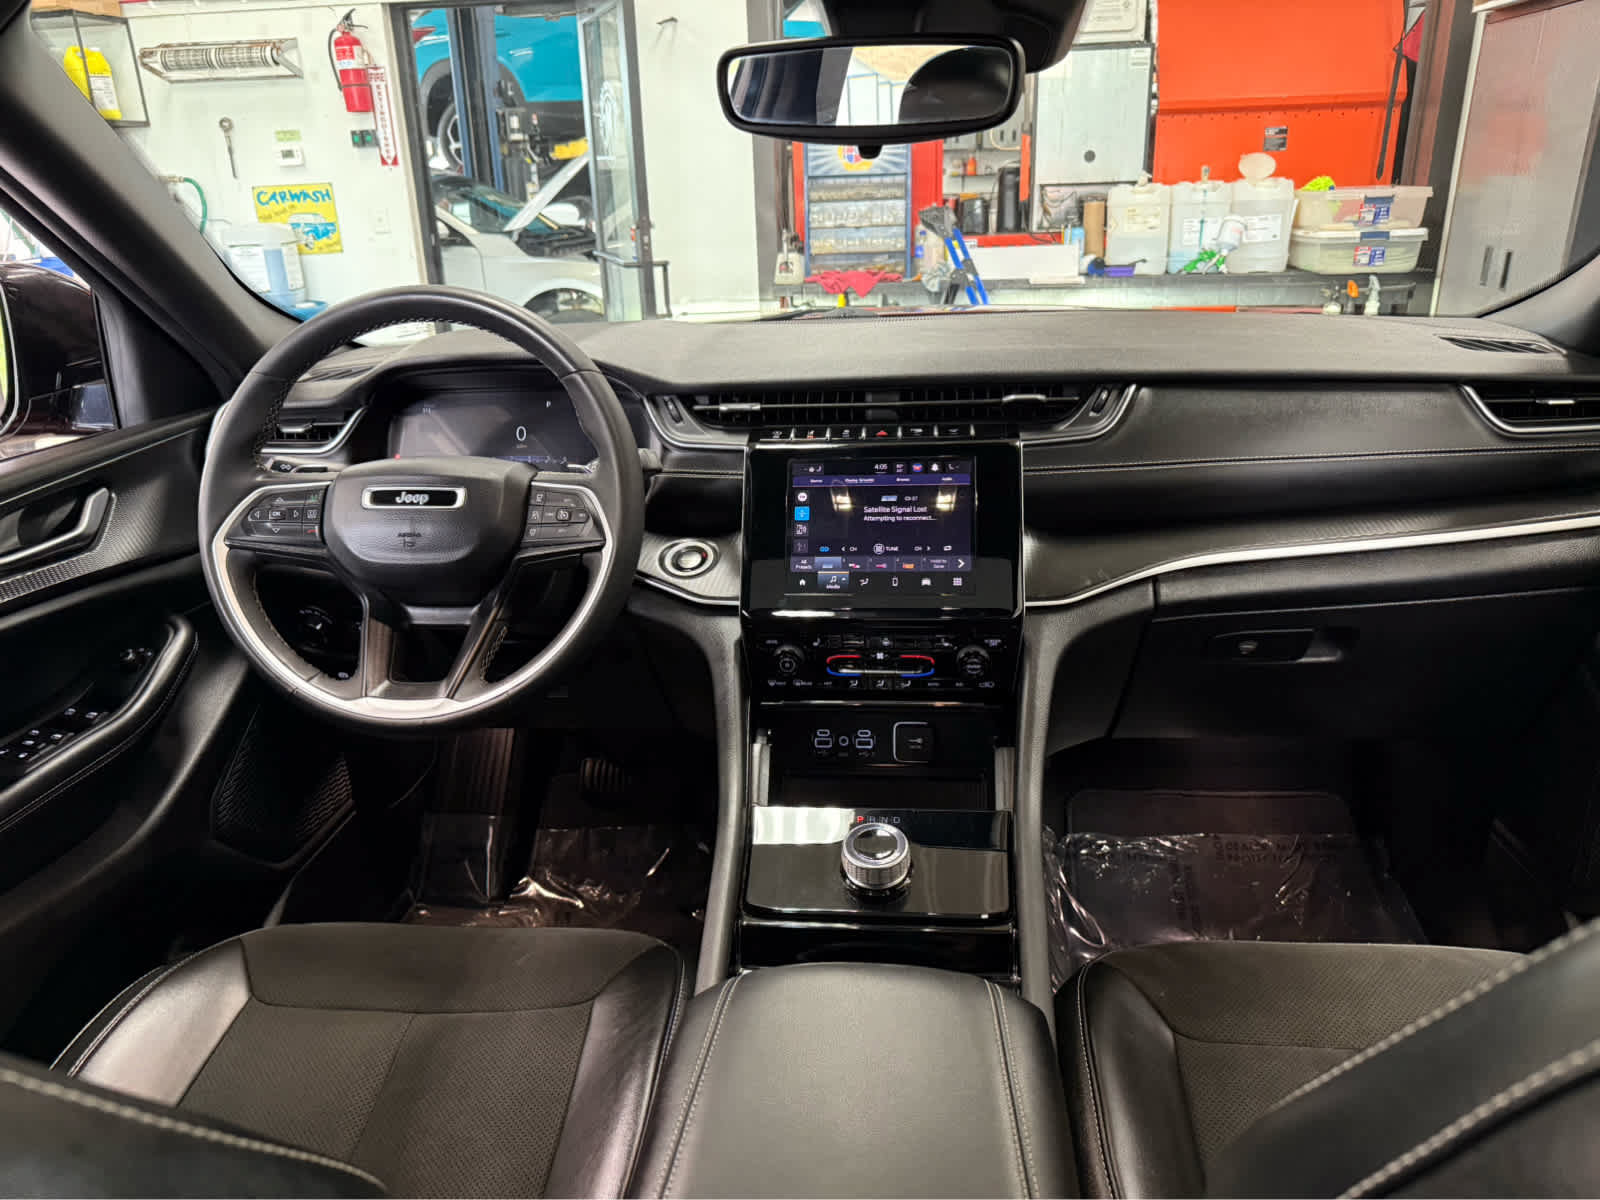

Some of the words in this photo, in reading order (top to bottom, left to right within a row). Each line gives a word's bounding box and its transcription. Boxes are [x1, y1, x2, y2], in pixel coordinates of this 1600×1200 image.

[516, 426, 527, 441] 0
[395, 491, 429, 505] Jeep
[891, 505, 912, 514] Signal
[913, 505, 928, 513] Lost
[863, 515, 896, 523] Attempting
